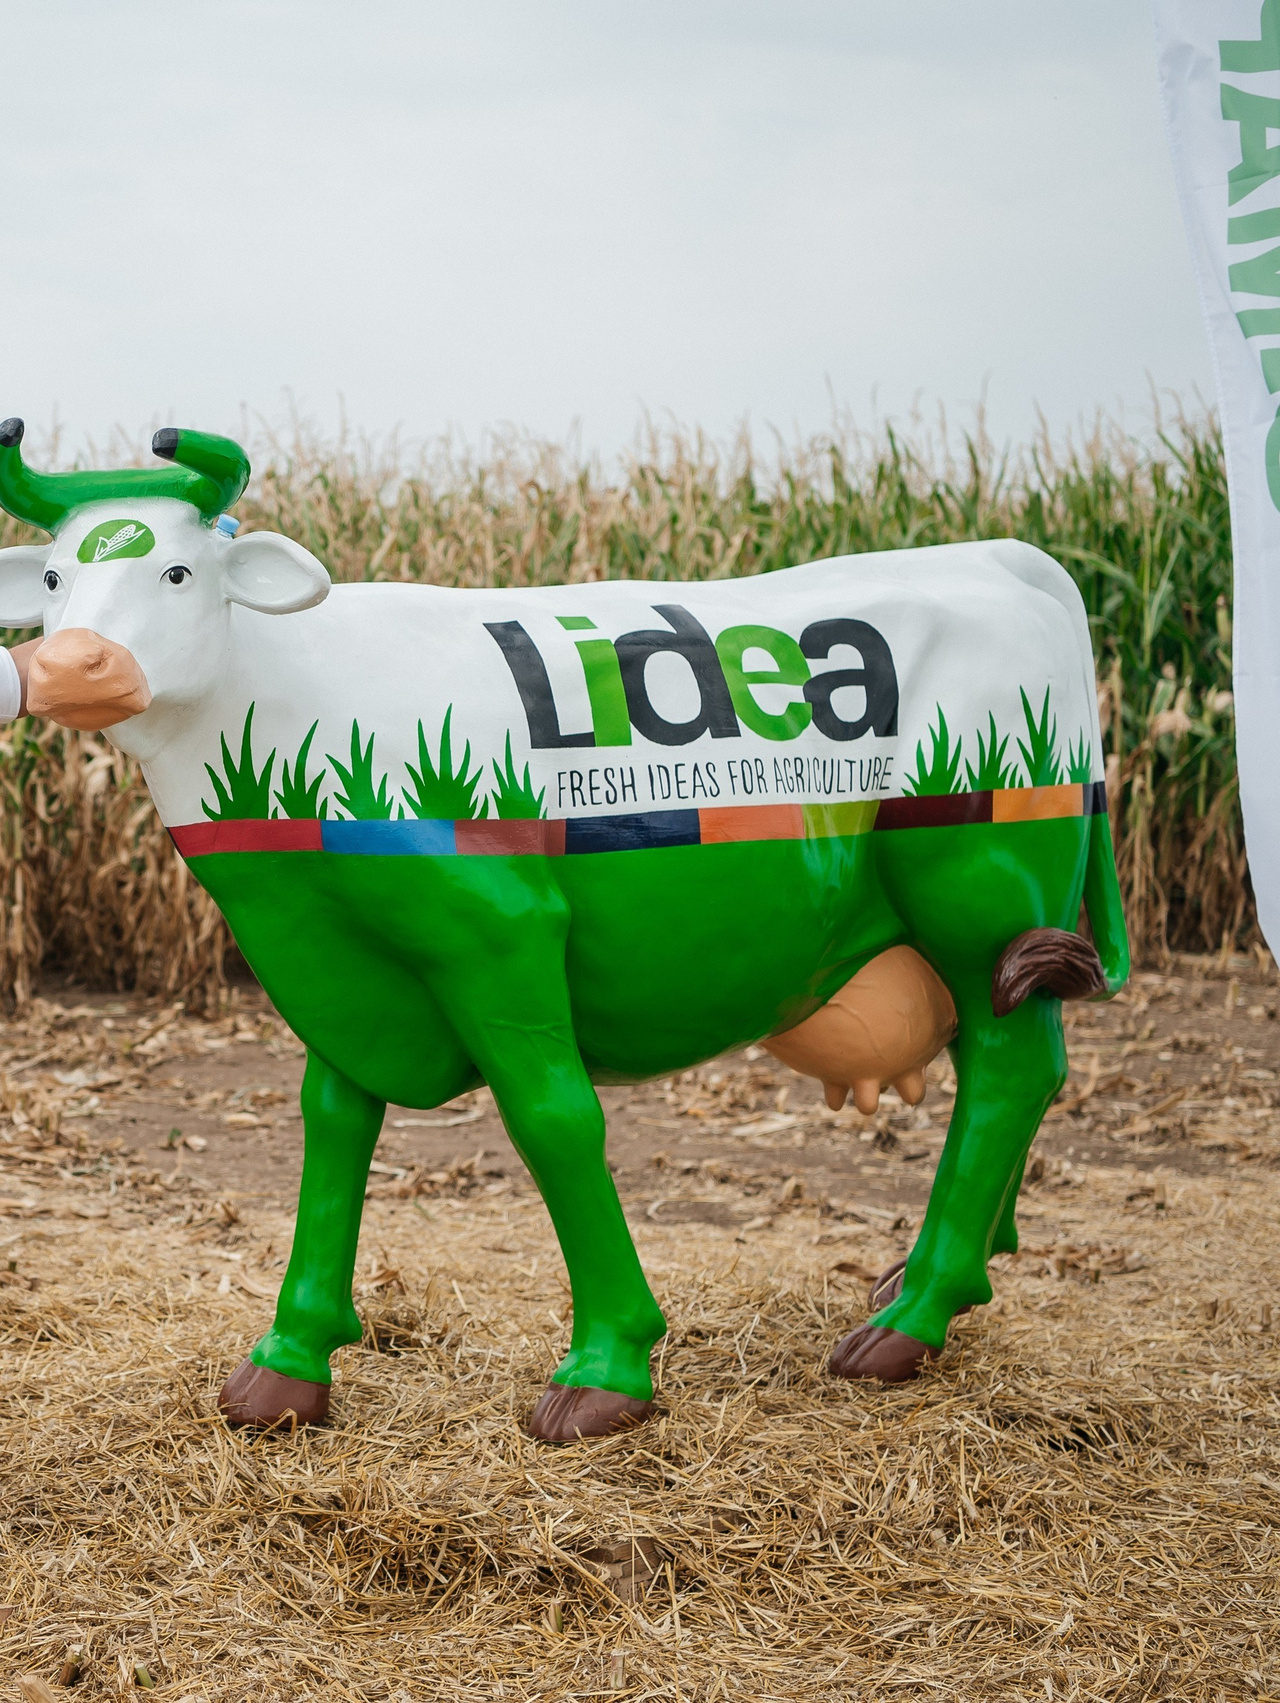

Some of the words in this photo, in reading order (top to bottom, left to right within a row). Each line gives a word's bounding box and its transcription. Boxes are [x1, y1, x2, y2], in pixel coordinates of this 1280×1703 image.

[483, 604, 899, 749] Lidea
[558, 767, 637, 808] FRESH
[648, 762, 720, 800] IDEAS
[727, 758, 768, 795] FOR
[773, 757, 894, 794] AGRICULTURE
